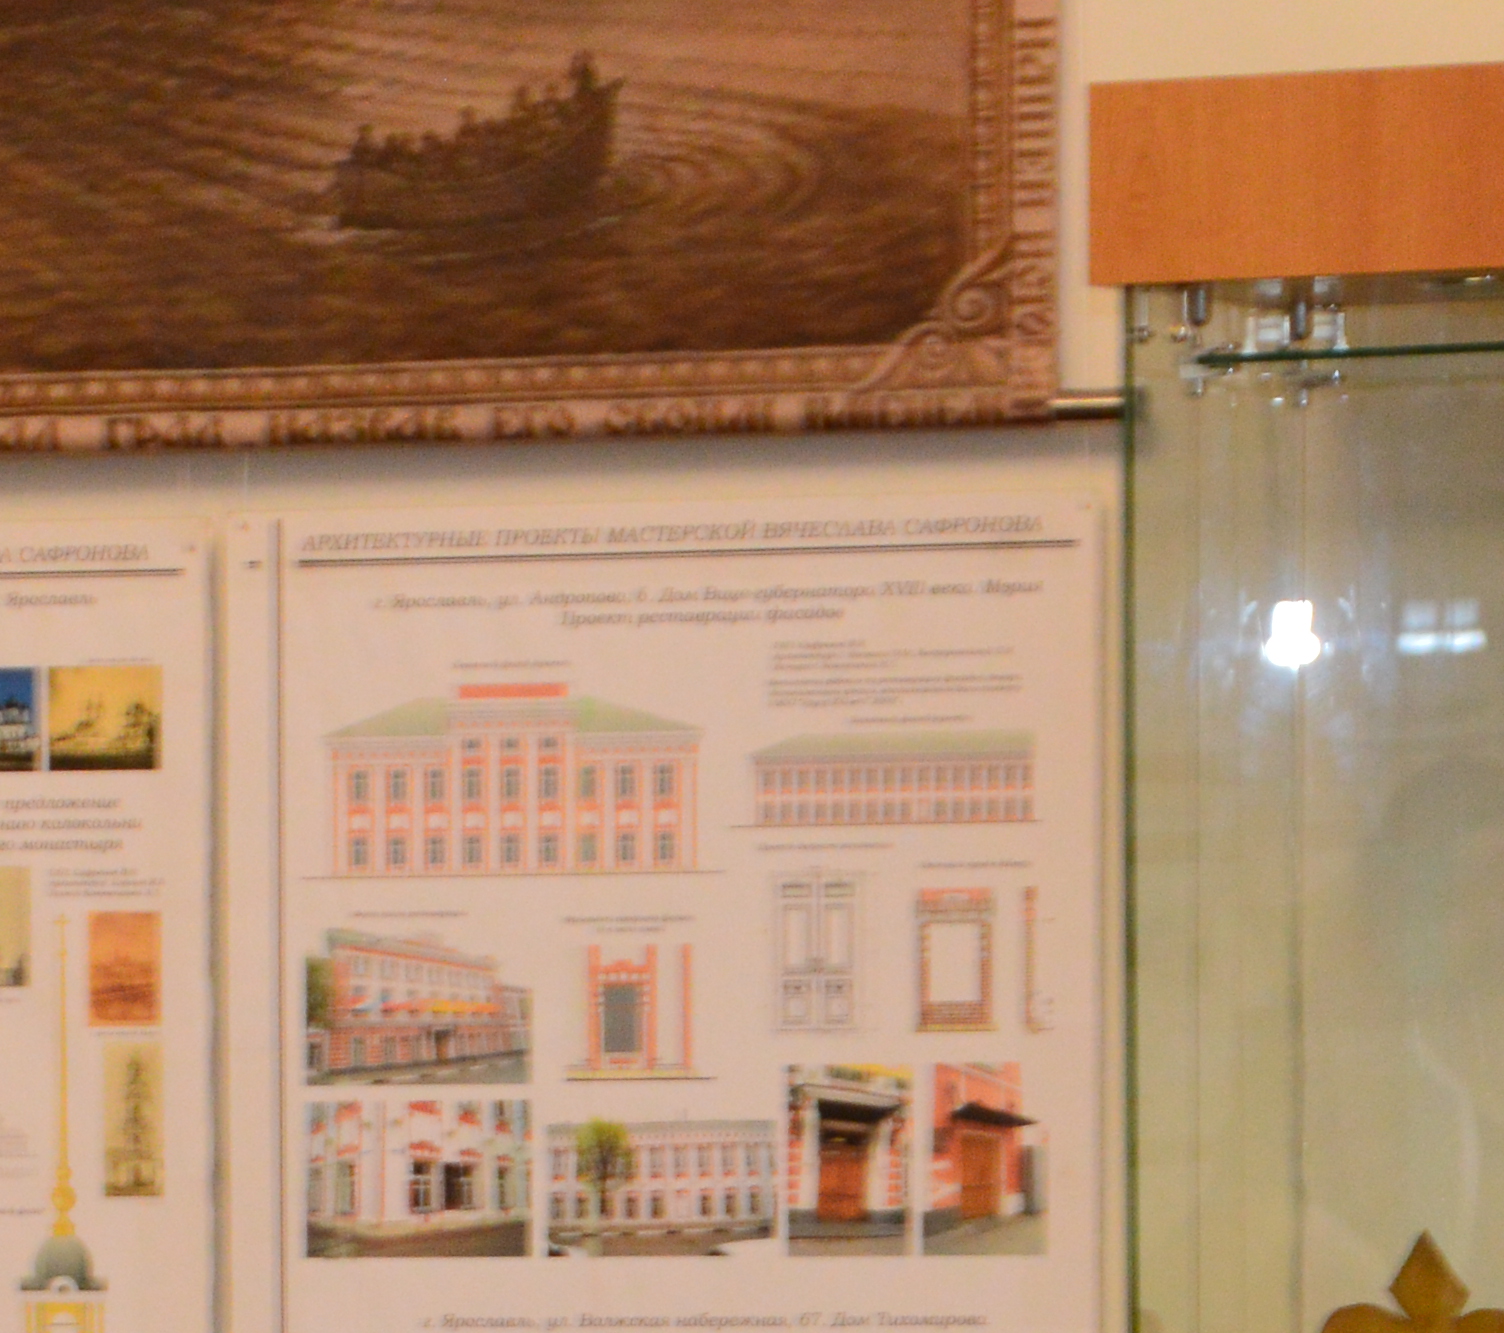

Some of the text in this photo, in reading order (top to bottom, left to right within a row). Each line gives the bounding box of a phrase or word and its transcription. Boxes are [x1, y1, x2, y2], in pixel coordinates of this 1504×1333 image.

[301, 514, 1044, 552] АРХИТЕКТУРНЫЕ ПРОЕКТЫ МАСТЕРСКОЙ ВЯЧЕСЛАВА САФРОНОВА
[18, 543, 150, 563] САФРОНОВА
